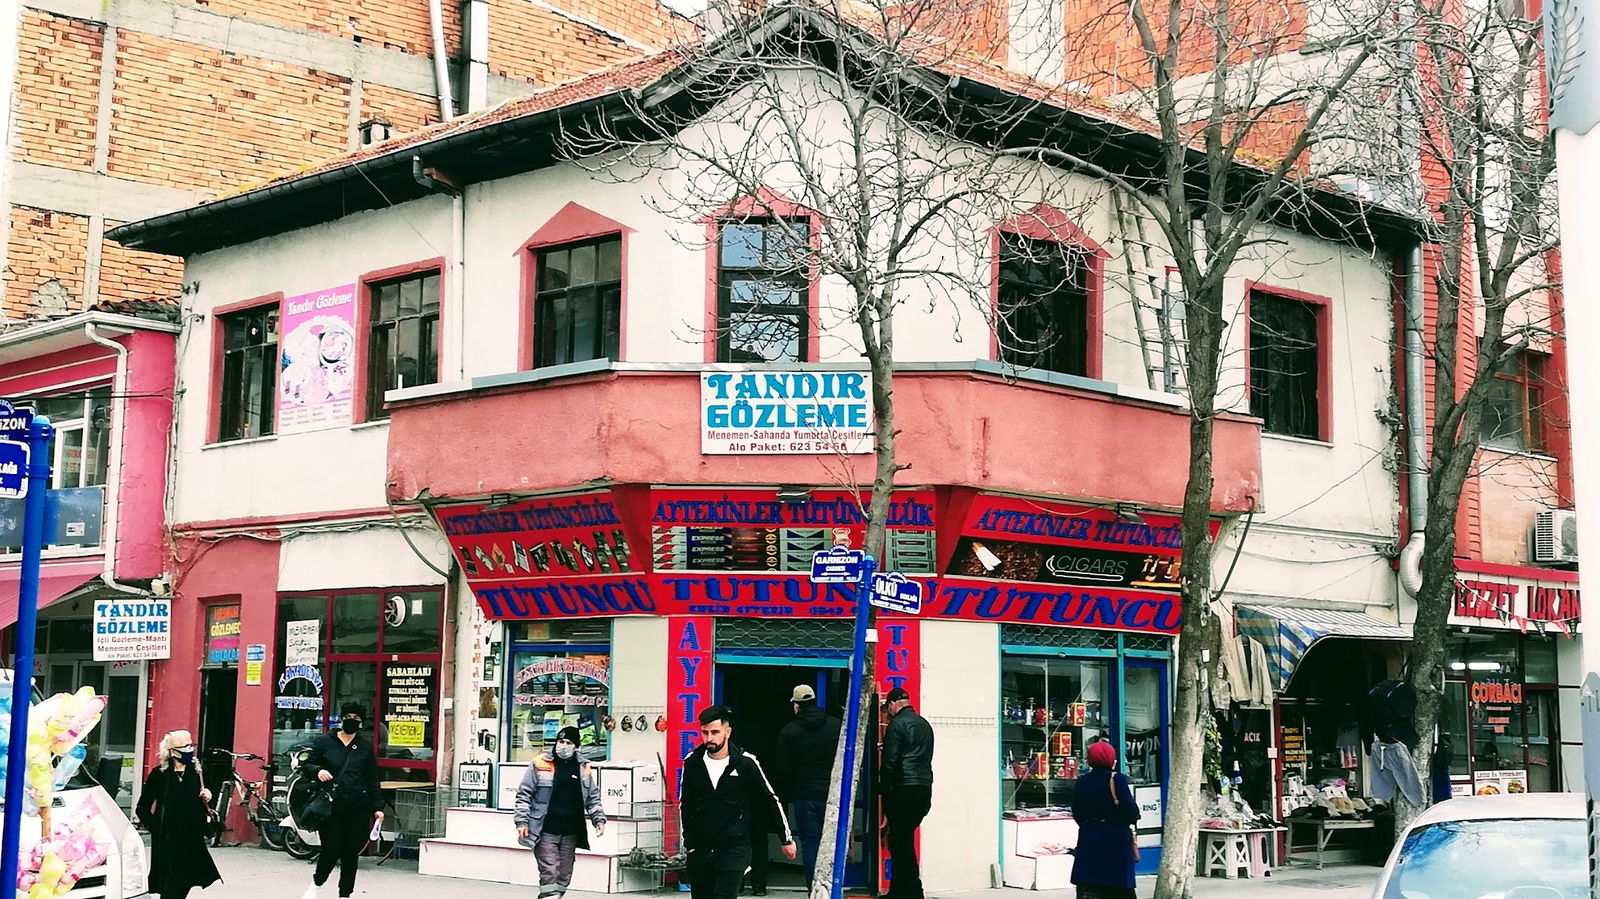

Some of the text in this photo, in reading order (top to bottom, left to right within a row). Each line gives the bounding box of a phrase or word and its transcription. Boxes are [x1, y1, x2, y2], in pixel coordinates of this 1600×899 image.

[315, 292, 353, 310] Gözleme
[707, 373, 866, 399] TANDIR
[707, 400, 867, 427] GÖZLEME
[708, 430, 790, 439] Menemen-Sahanda
[729, 442, 746, 451] Alo
[751, 442, 785, 451] Paket:
[790, 442, 811, 451] 623
[815, 442, 829, 451] 54
[652, 494, 935, 526] AYTEKİNLER TÜTÜNLÜK
[1056, 555, 1129, 575] CIGARS
[1455, 580, 1519, 620] LEZZET
[97, 603, 168, 617] TANDIR
[97, 618, 168, 634] GÖZLEME
[1471, 682, 1522, 708] ÇORBACI
[1243, 732, 1261, 742] AÇIK
[607, 788, 624, 797] RING
